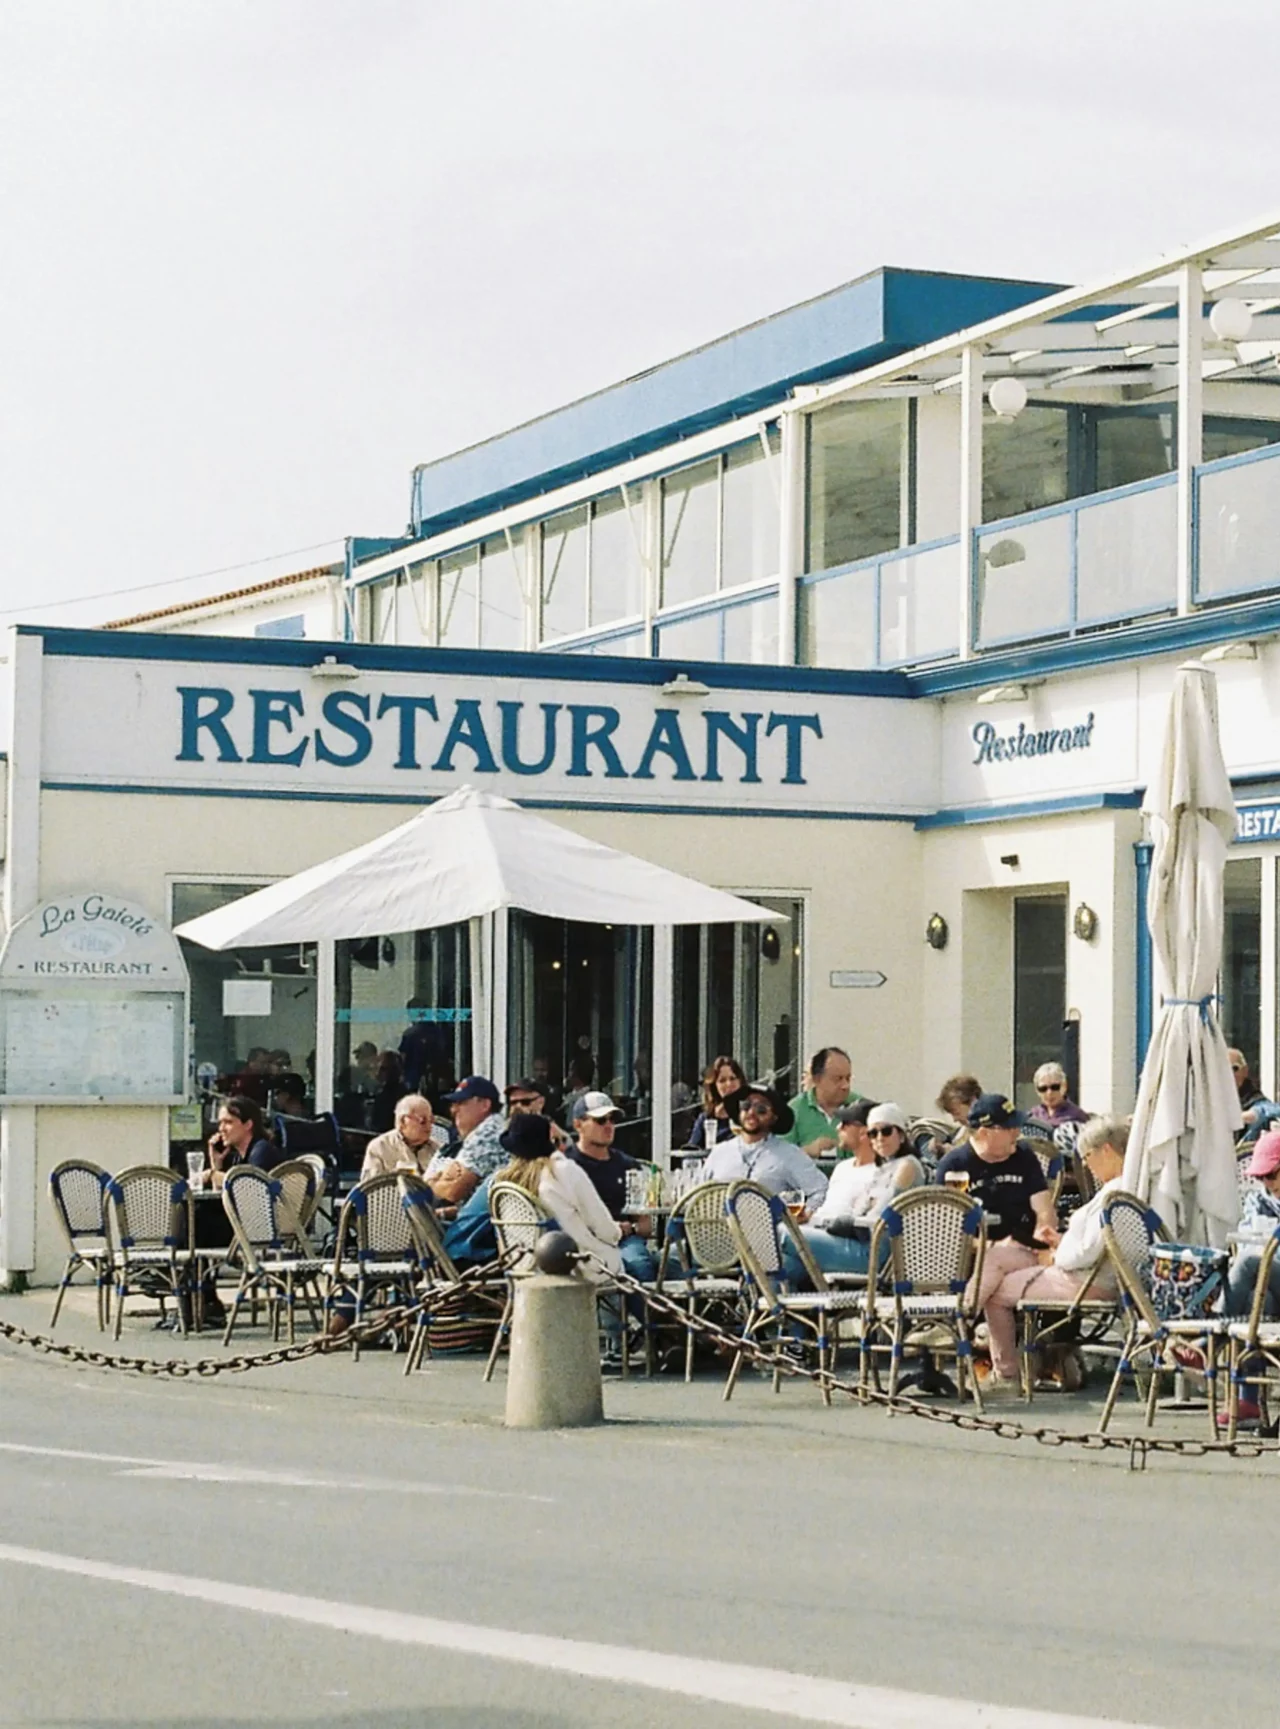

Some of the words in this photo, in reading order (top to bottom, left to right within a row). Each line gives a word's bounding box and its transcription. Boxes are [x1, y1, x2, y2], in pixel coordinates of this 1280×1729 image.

[175, 685, 825, 785] RESTAURANT
[972, 711, 1095, 765] Restaurant
[40, 905, 75, 937] La
[83, 895, 153, 936] Gaieté
[34, 961, 153, 975] RESTAURANT
